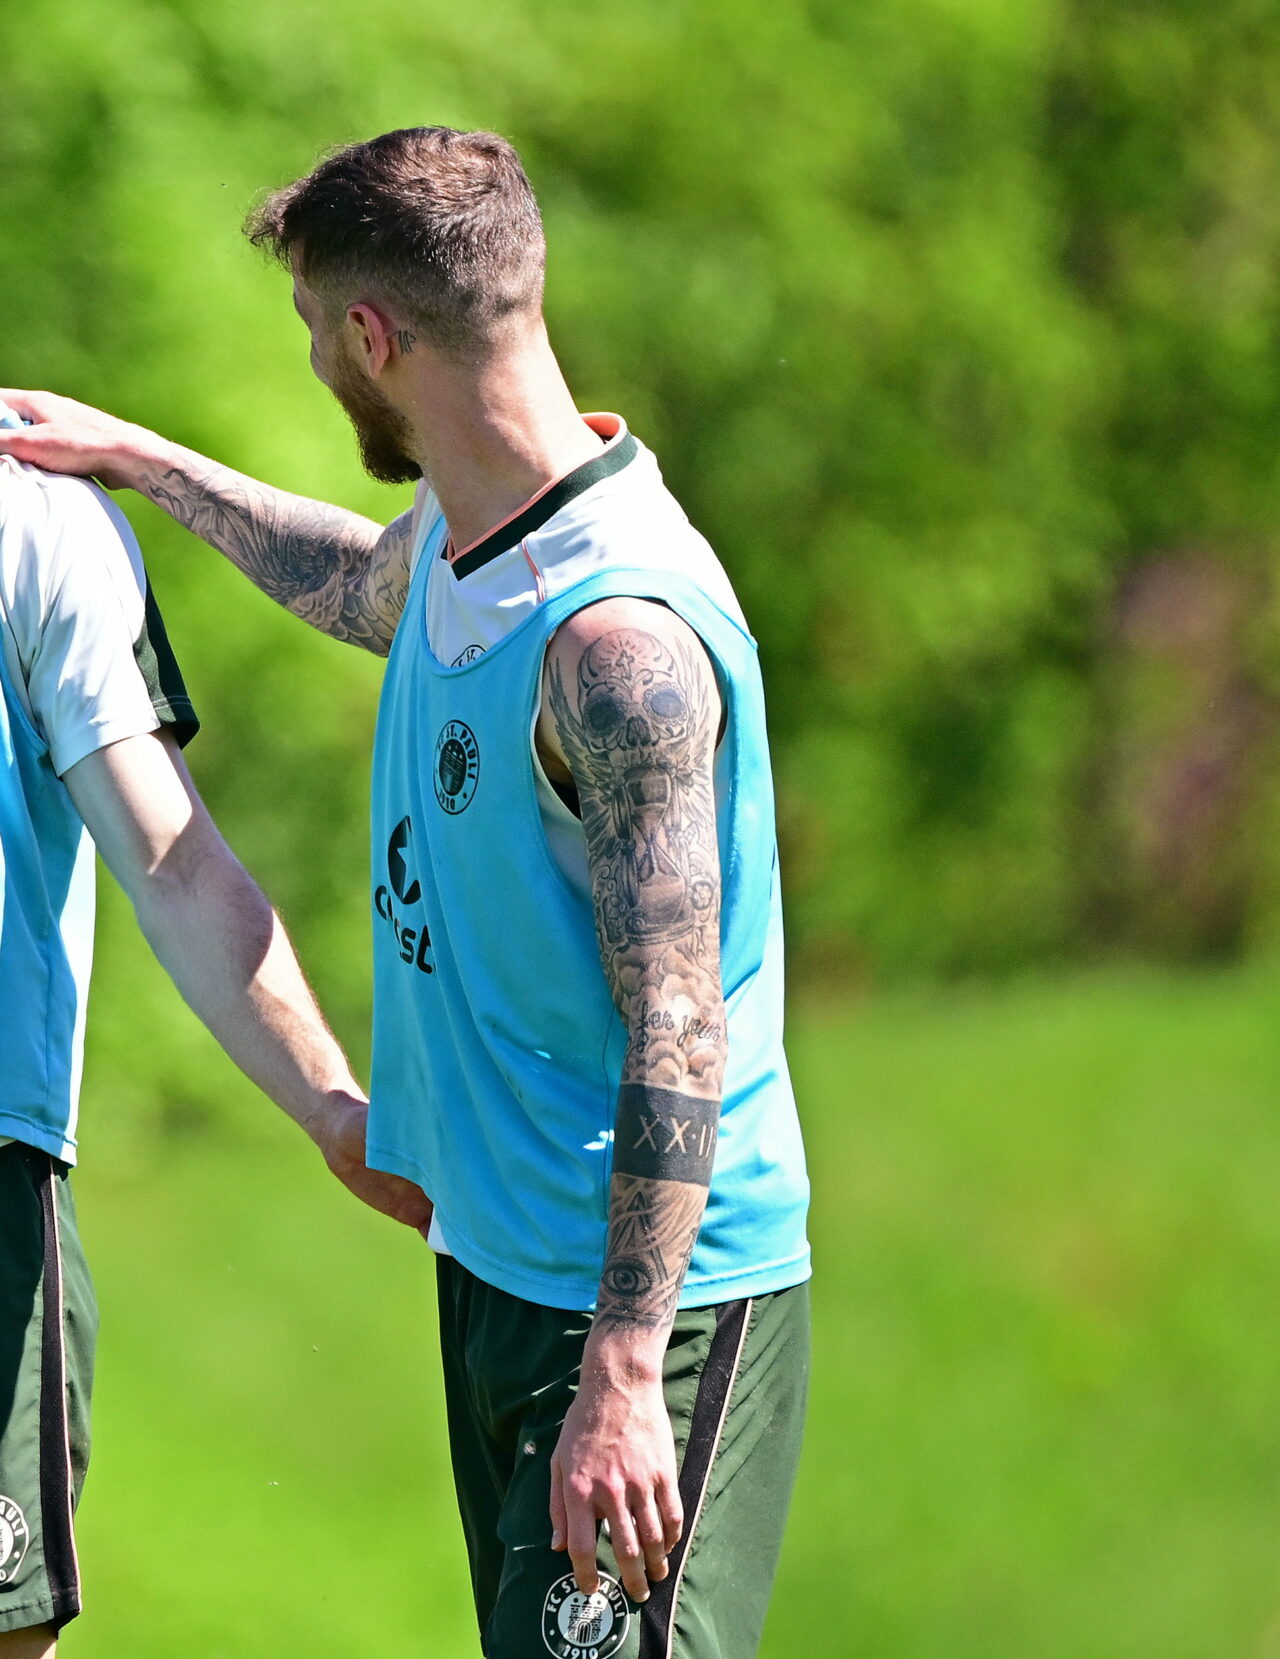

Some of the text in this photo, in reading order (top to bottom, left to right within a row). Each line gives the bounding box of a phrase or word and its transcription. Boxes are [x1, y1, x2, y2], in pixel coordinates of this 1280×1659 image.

[460, 729, 477, 780] PAULI
[546, 1593, 562, 1613] FC
[598, 1580, 626, 1618] AULI
